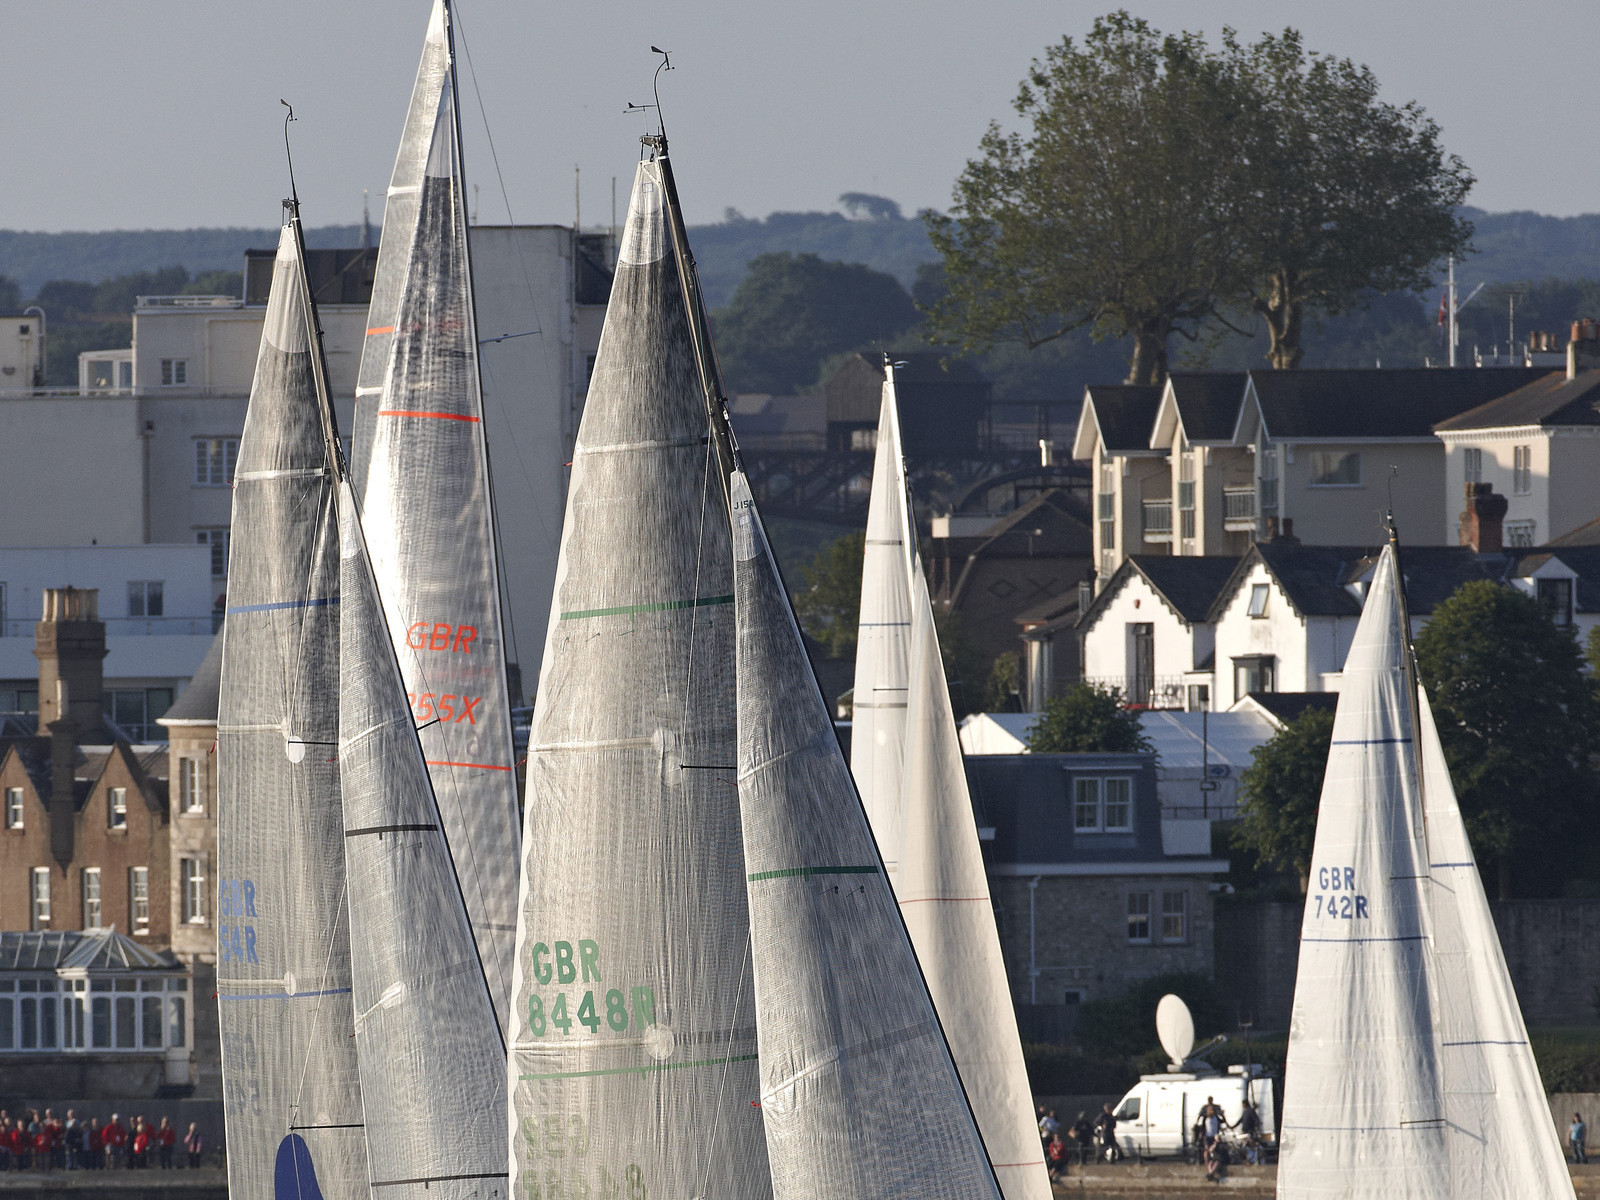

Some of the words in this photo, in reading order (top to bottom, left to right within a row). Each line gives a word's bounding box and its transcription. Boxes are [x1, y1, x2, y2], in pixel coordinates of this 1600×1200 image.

[407, 622, 477, 654] GBR
[1319, 867, 1355, 890] GBR
[221, 879, 257, 917] GBR
[1315, 895, 1369, 919] 742R
[532, 939, 603, 985] GBR
[528, 986, 656, 1037] 8448R
